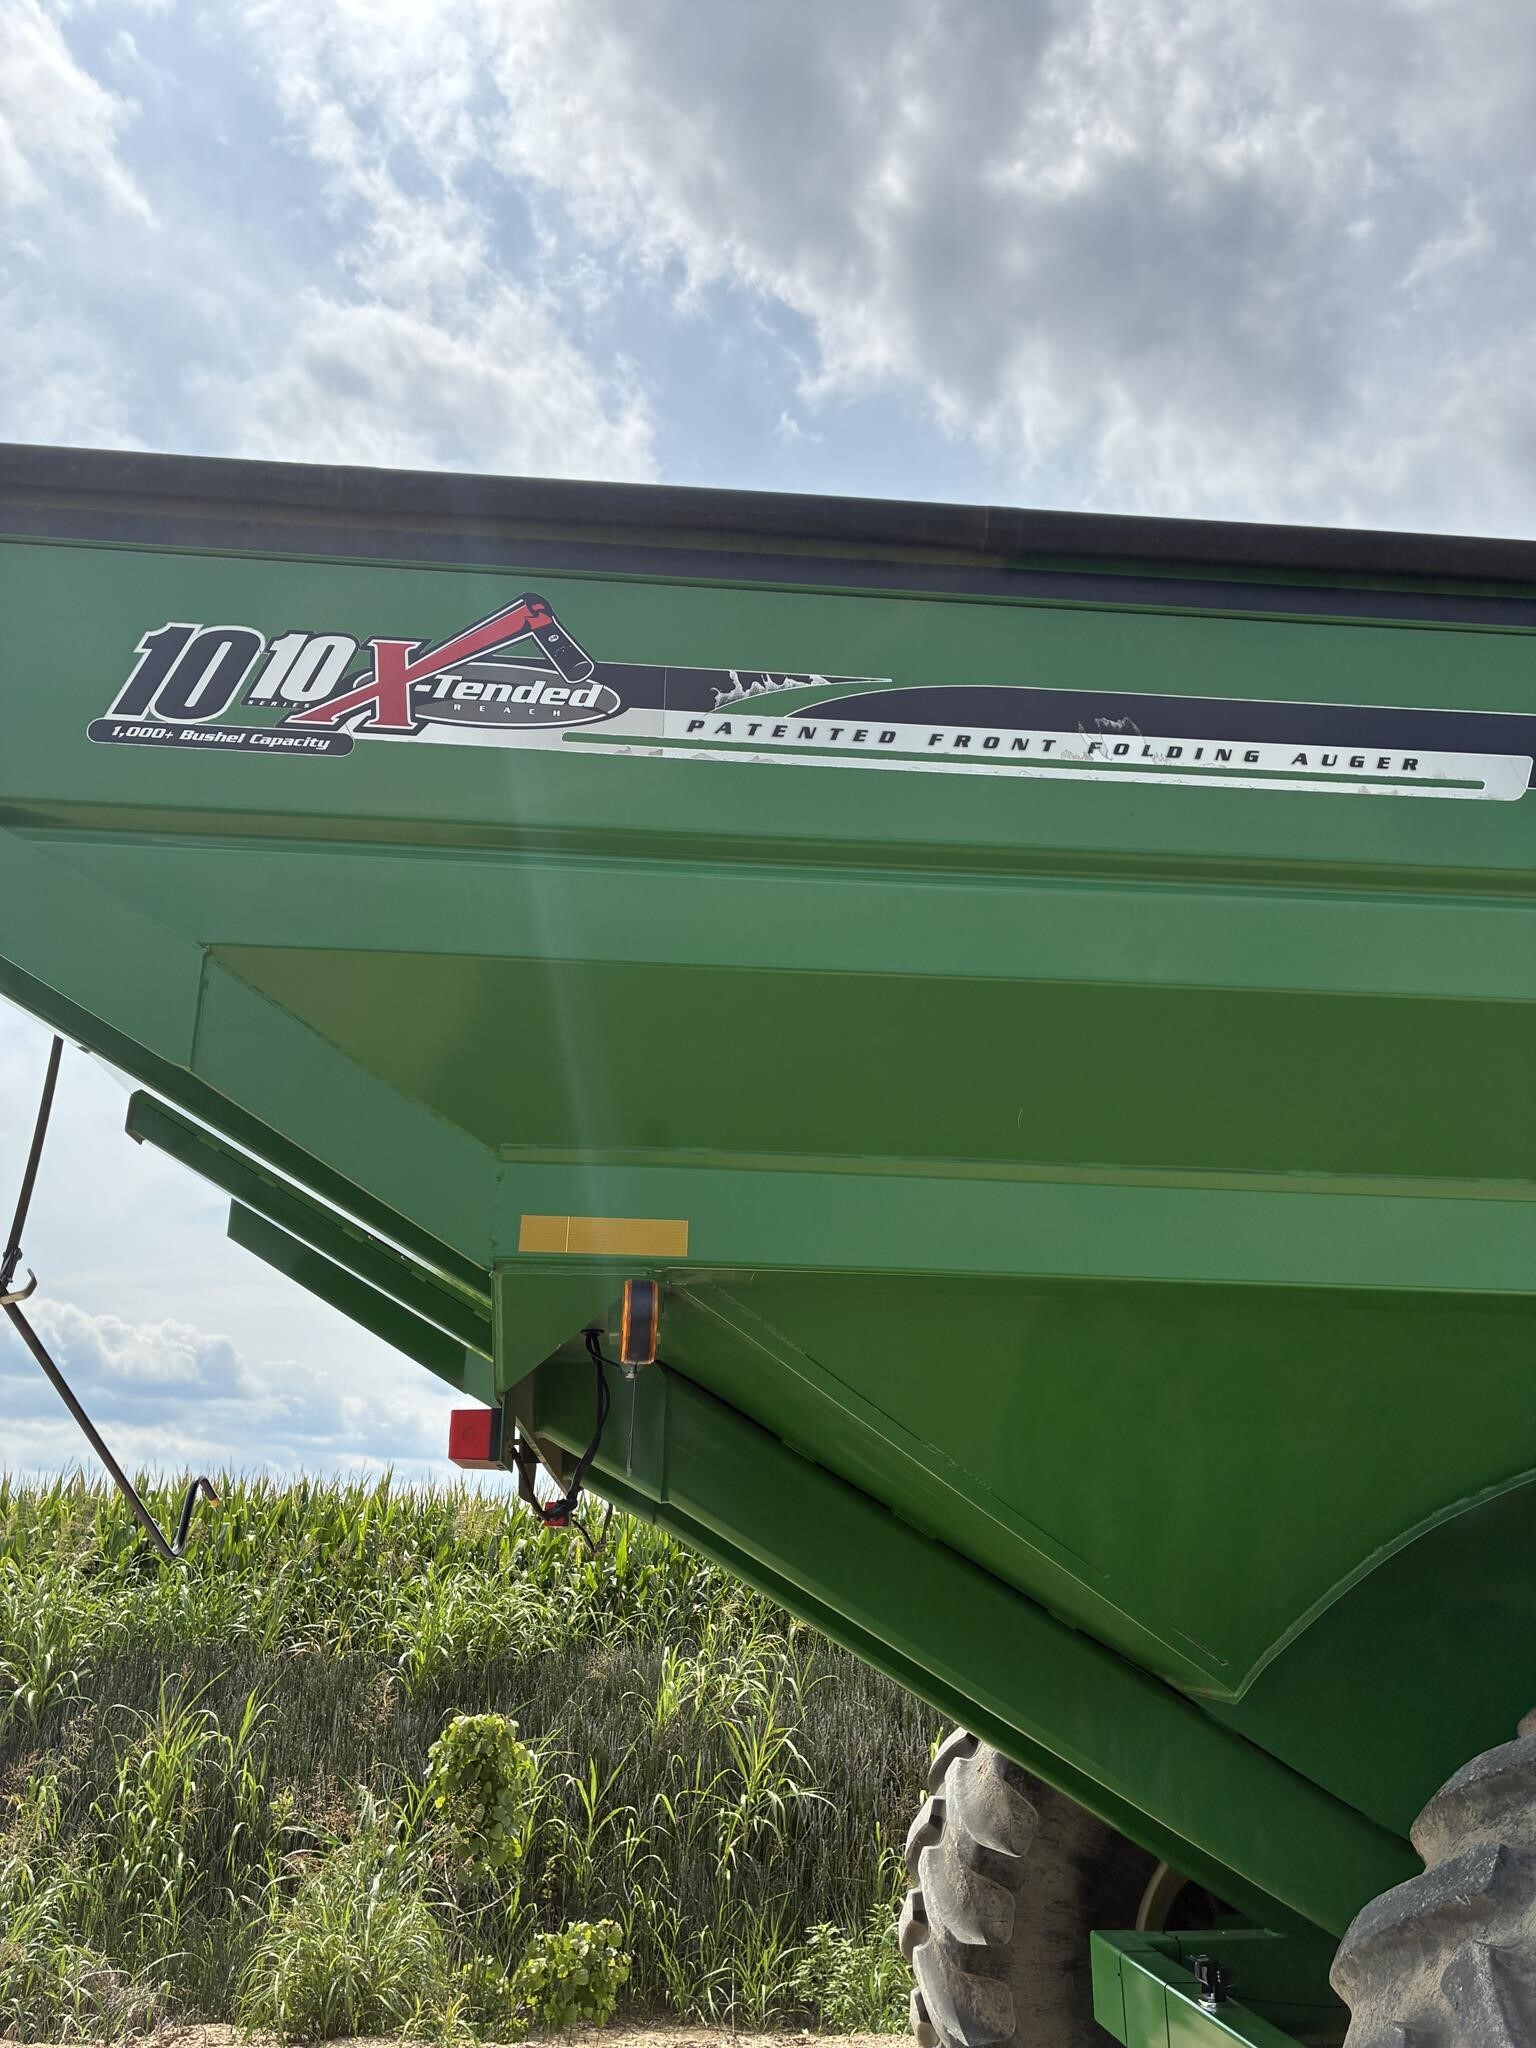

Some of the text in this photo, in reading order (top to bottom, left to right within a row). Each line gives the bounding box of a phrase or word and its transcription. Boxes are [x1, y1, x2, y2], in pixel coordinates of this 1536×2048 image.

[247, 699, 311, 709] SERIES
[453, 703, 561, 718] REACH
[111, 726, 331, 750] 1,000+ Bushel Capacity
[686, 719, 1419, 771] PATENTED FRONT FOLDING AUGER
